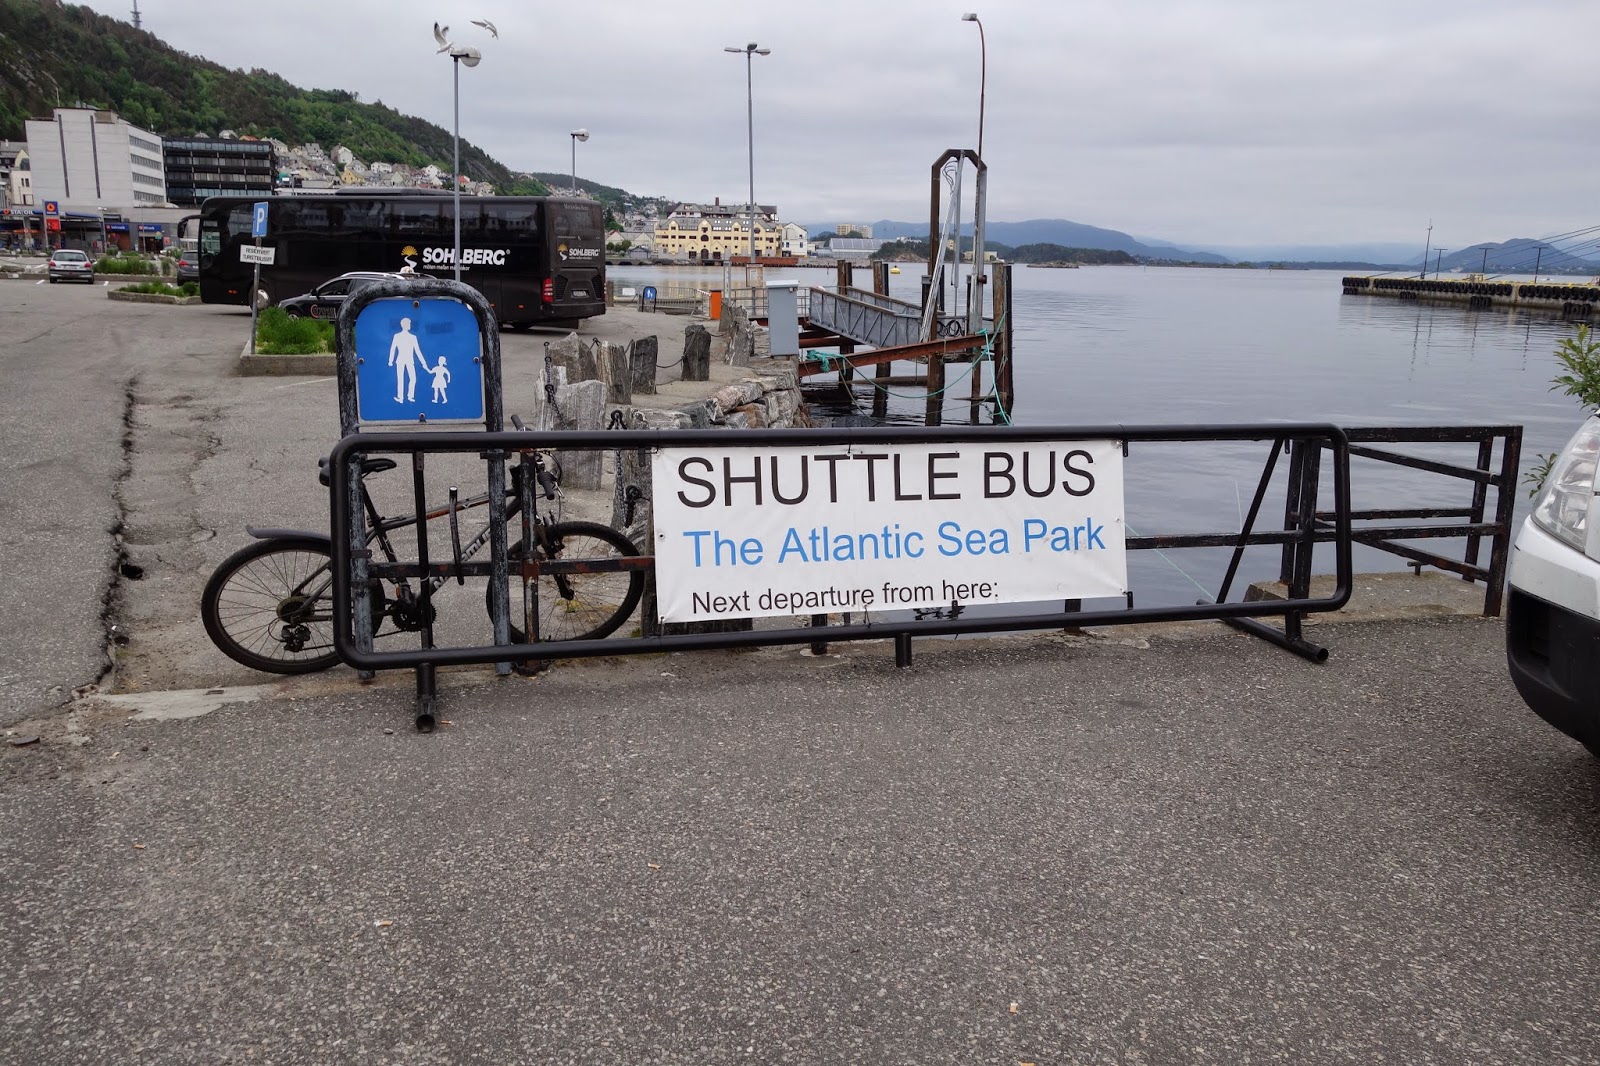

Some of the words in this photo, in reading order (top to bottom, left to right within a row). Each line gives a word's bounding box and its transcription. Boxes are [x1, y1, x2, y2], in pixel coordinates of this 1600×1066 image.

[256, 207, 265, 233] P
[422, 247, 506, 265] SOHBERG
[677, 451, 962, 508] SHUTTLE
[983, 449, 1096, 499] BUS
[683, 530, 764, 568] The
[778, 523, 924, 564] Atlantic
[937, 520, 1010, 557] Sea
[1023, 517, 1107, 552] Park
[692, 589, 750, 614] Next
[758, 584, 875, 614] departure
[882, 581, 934, 605] from
[943, 578, 999, 602] here:
